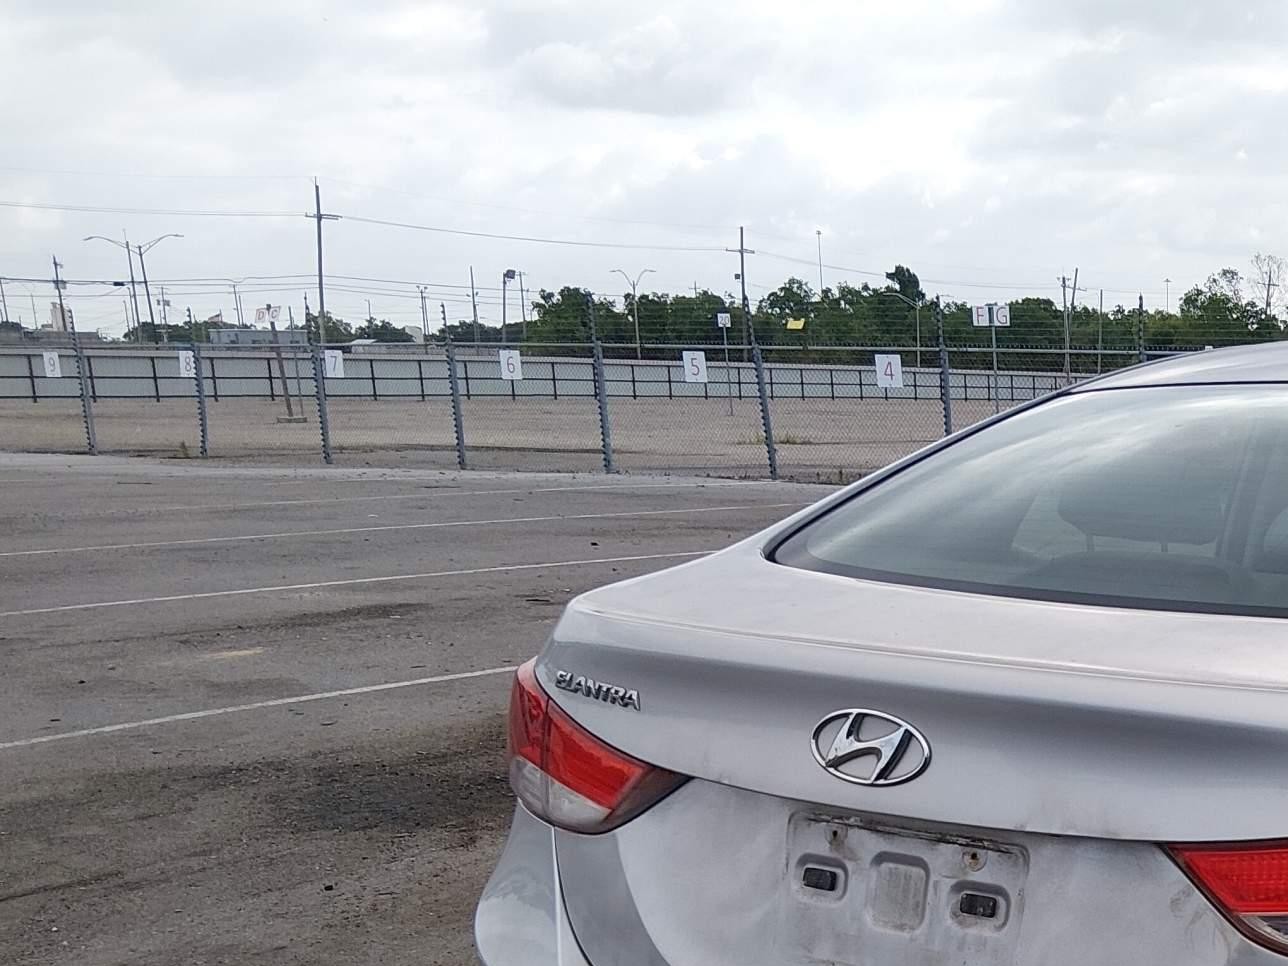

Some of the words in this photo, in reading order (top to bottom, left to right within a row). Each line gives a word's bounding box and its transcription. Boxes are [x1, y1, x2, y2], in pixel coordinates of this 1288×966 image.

[976, 306, 985, 325] F
[995, 306, 1008, 325] G
[48, 356, 56, 373] 9
[184, 355, 192, 373] 8
[328, 355, 338, 373] 7
[506, 356, 516, 374] 6
[690, 357, 700, 376] 5
[883, 360, 896, 381] 4
[555, 670, 641, 711] ELANTRA
